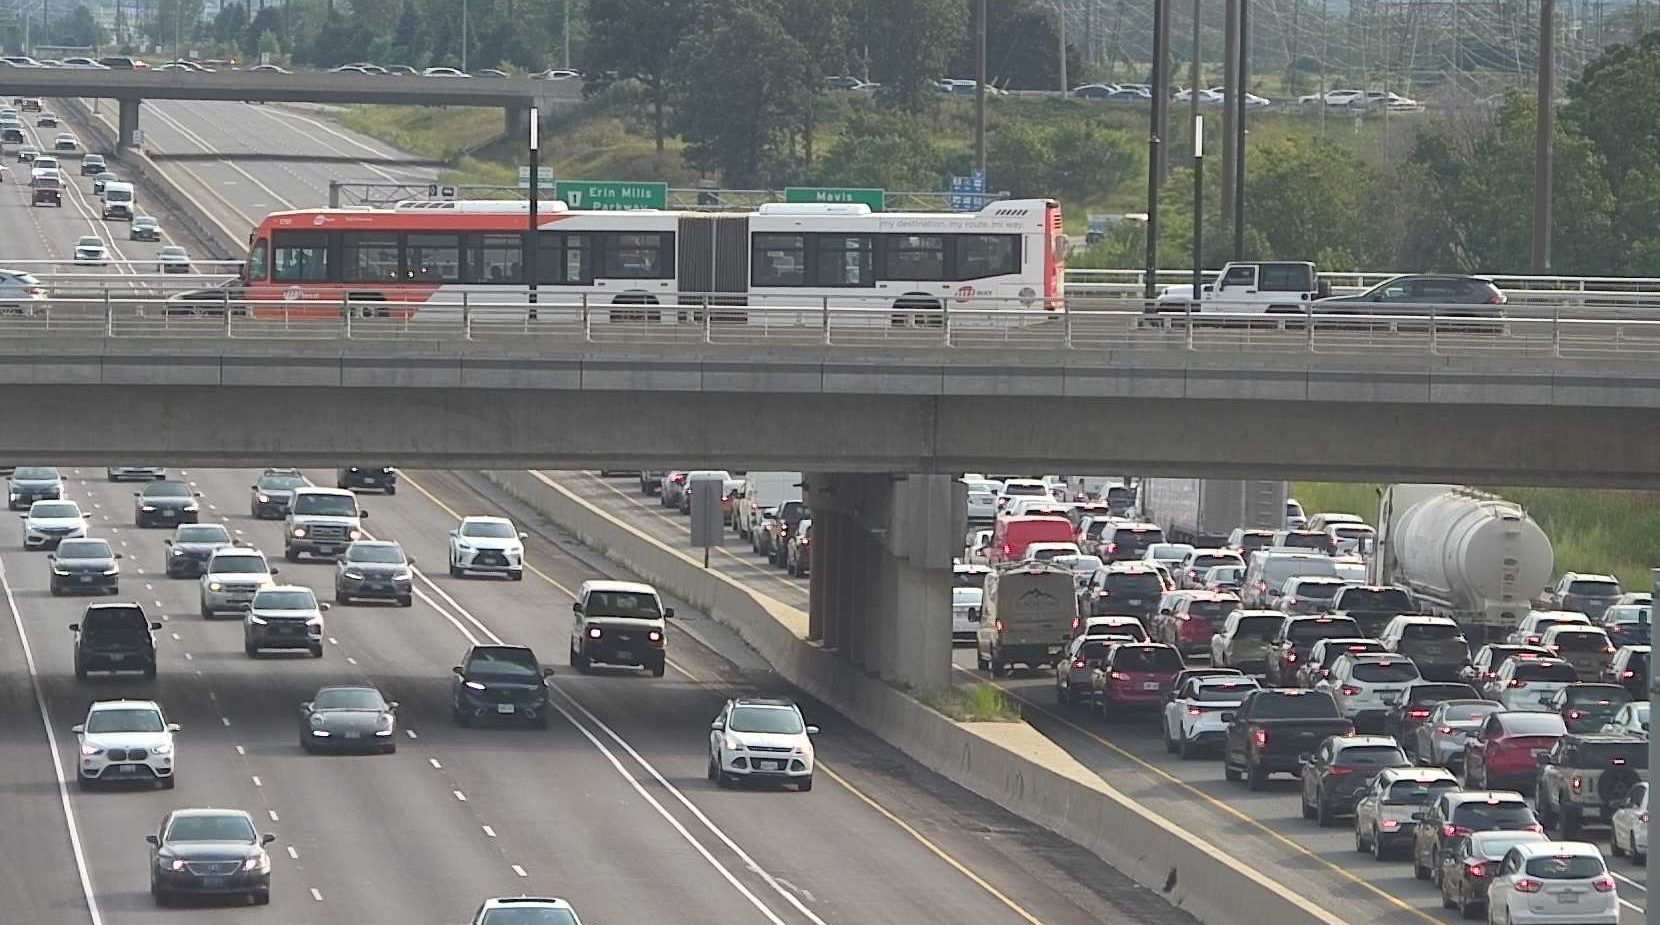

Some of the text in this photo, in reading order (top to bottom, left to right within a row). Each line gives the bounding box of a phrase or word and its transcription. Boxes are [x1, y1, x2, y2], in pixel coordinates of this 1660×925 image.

[589, 187, 652, 198] Erin Mills
[816, 191, 853, 202] Mavis
